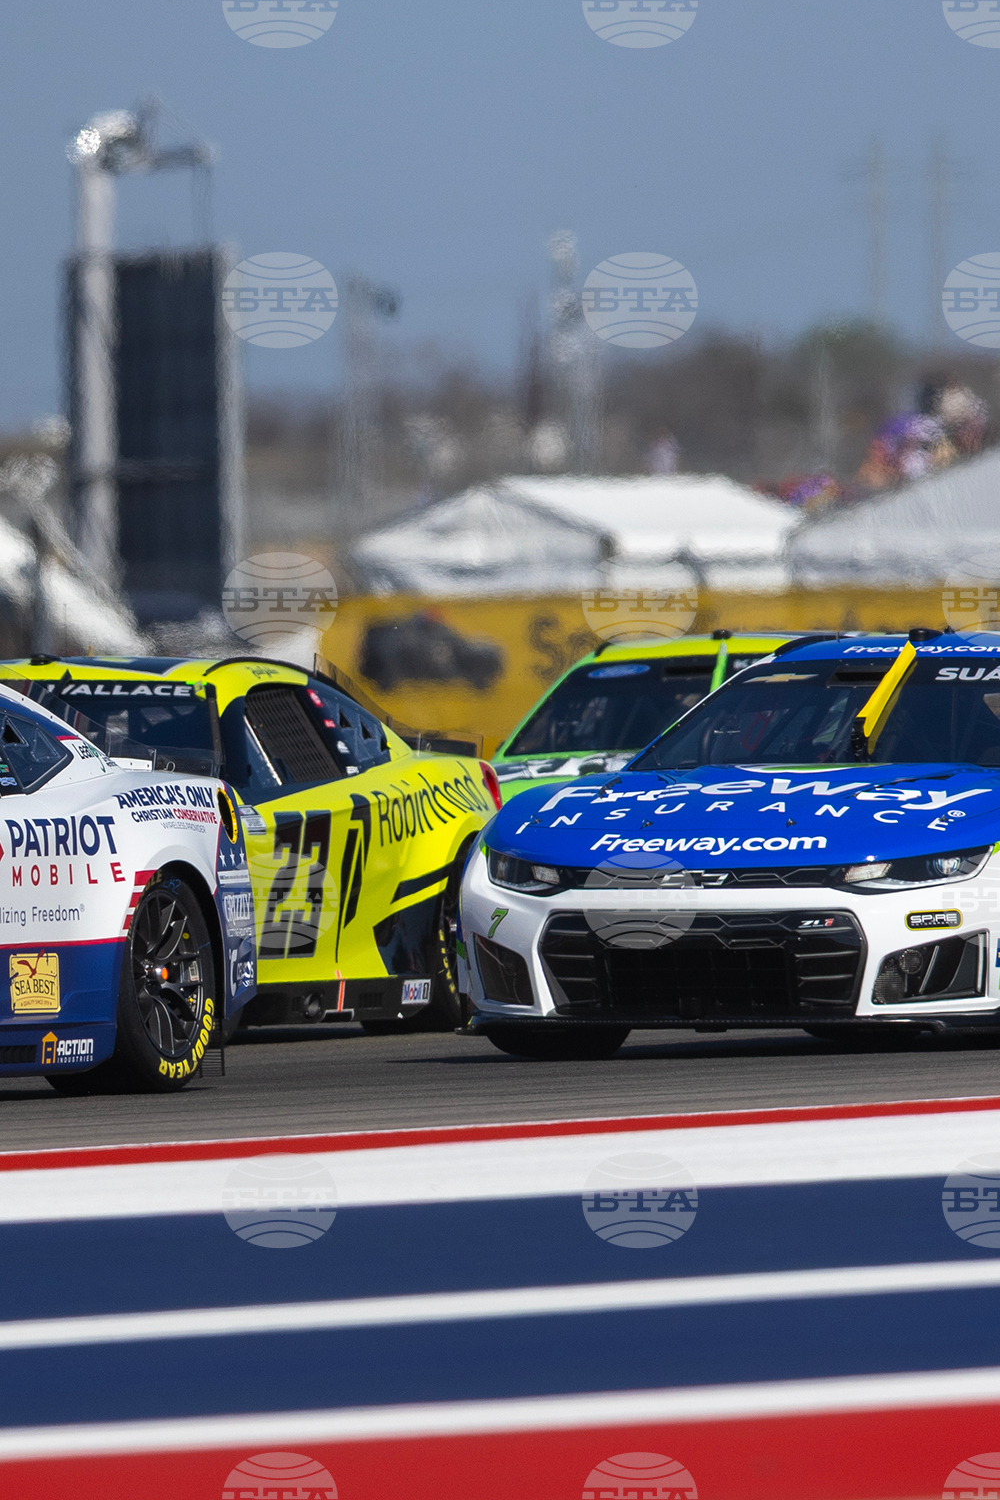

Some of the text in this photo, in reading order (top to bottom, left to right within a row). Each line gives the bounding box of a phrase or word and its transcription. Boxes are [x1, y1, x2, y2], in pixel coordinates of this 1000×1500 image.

[113, 785, 215, 810] AMERICA'S ONLY
[371, 761, 489, 847] Robinhood
[538, 777, 993, 813] Freeway
[131, 808, 218, 825] CHRISTIAN CONSERVATIVE
[4, 815, 118, 858] PATRIOT
[589, 833, 828, 855] Freeway.com
[12, 862, 126, 887] MOBILE
[257, 810, 331, 960] 23
[488, 908, 509, 938] 7
[798, 917, 834, 928] ZL1
[910, 913, 957, 923] SPIRE
[14, 979, 55, 997] SEA BEST
[403, 980, 422, 1001] Mobil
[57, 1039, 93, 1056] ACTION
[159, 998, 214, 1078] GOODYEAR
[57, 1055, 93, 1063] INDUSTRIES
